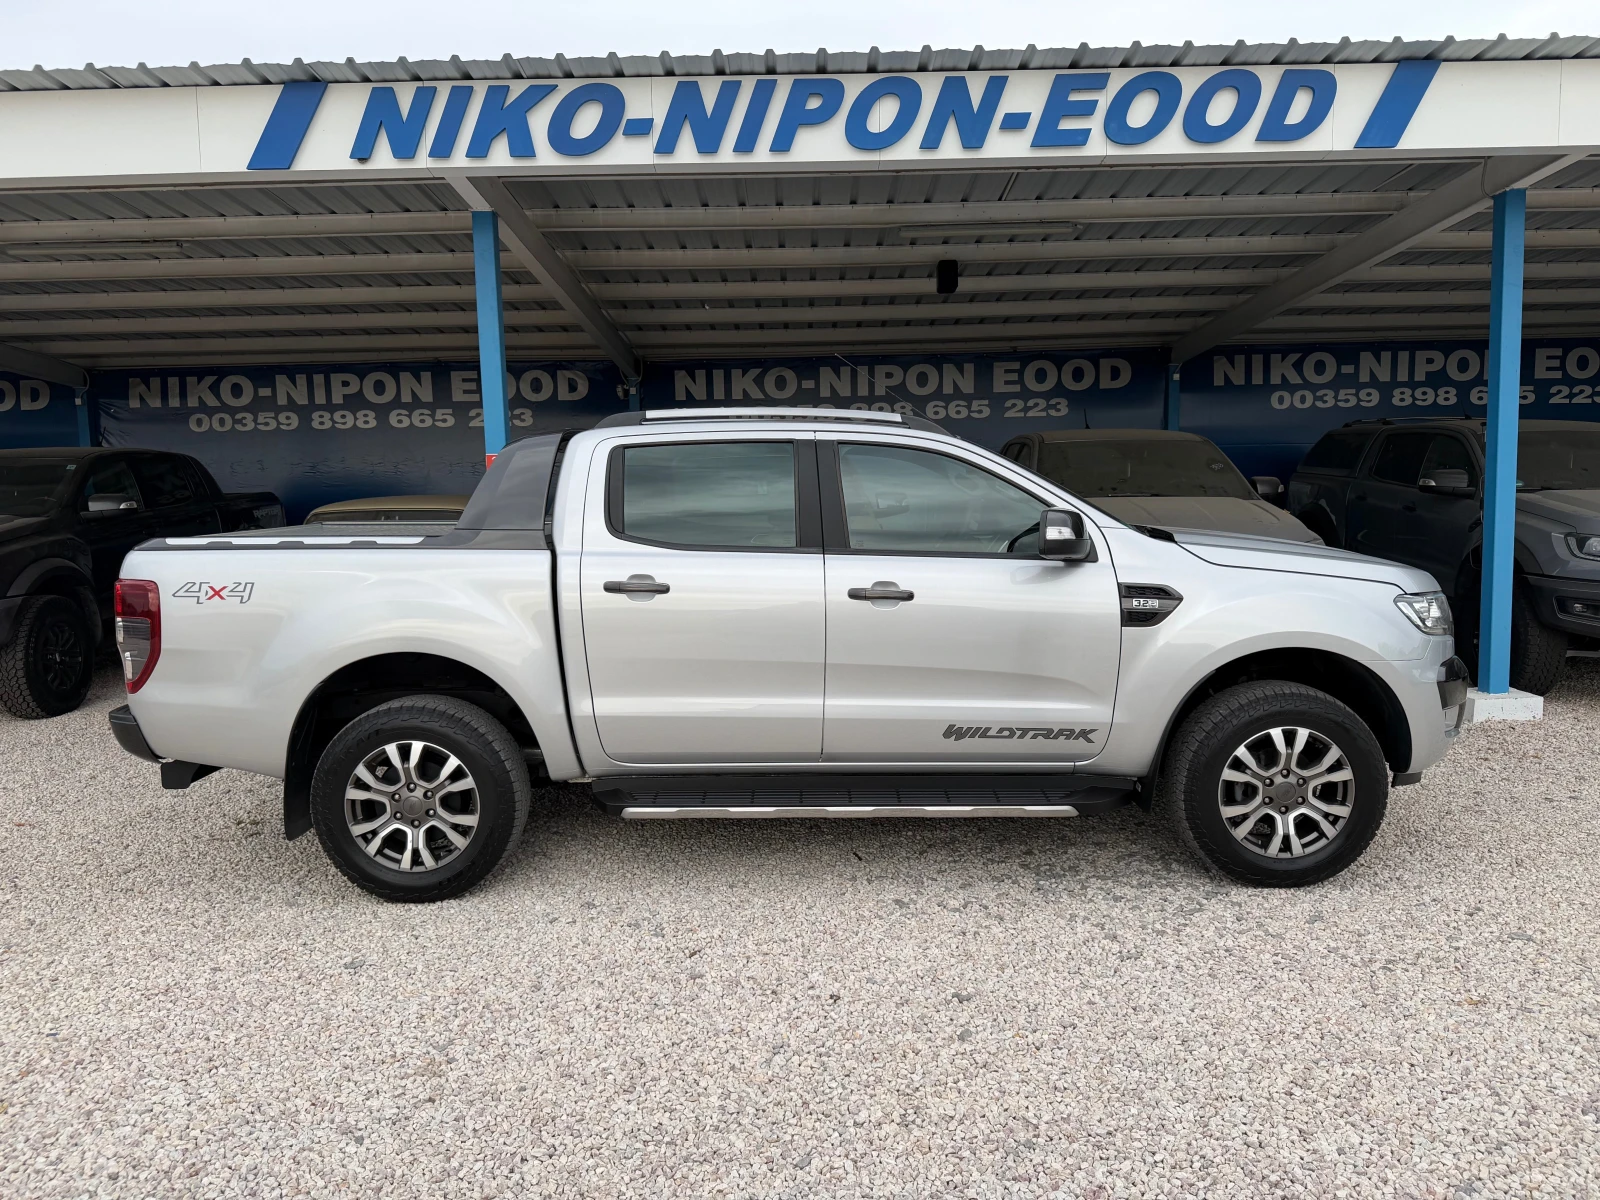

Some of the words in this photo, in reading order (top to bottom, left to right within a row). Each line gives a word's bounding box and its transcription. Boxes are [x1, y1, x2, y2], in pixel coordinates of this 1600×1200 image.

[674, 363, 975, 400] NIKO-NIPON
[993, 358, 1132, 393] EOOD
[1213, 349, 1489, 387] NIKO-NIPO
[1534, 347, 1600, 379] EO
[128, 371, 434, 408] NIKO-NIPON
[450, 370, 589, 402] EOD
[1270, 388, 1380, 410] 00359
[1392, 386, 1458, 407] 898
[1469, 386, 1536, 405] 65
[188, 411, 299, 432] 00359
[311, 410, 377, 429] 898
[388, 408, 455, 428] 665
[468, 407, 534, 427] 23
[926, 399, 991, 420] 665
[1003, 398, 1069, 418] 223
[172, 582, 255, 604] 4x4
[942, 724, 1099, 743] WILDTRAK
